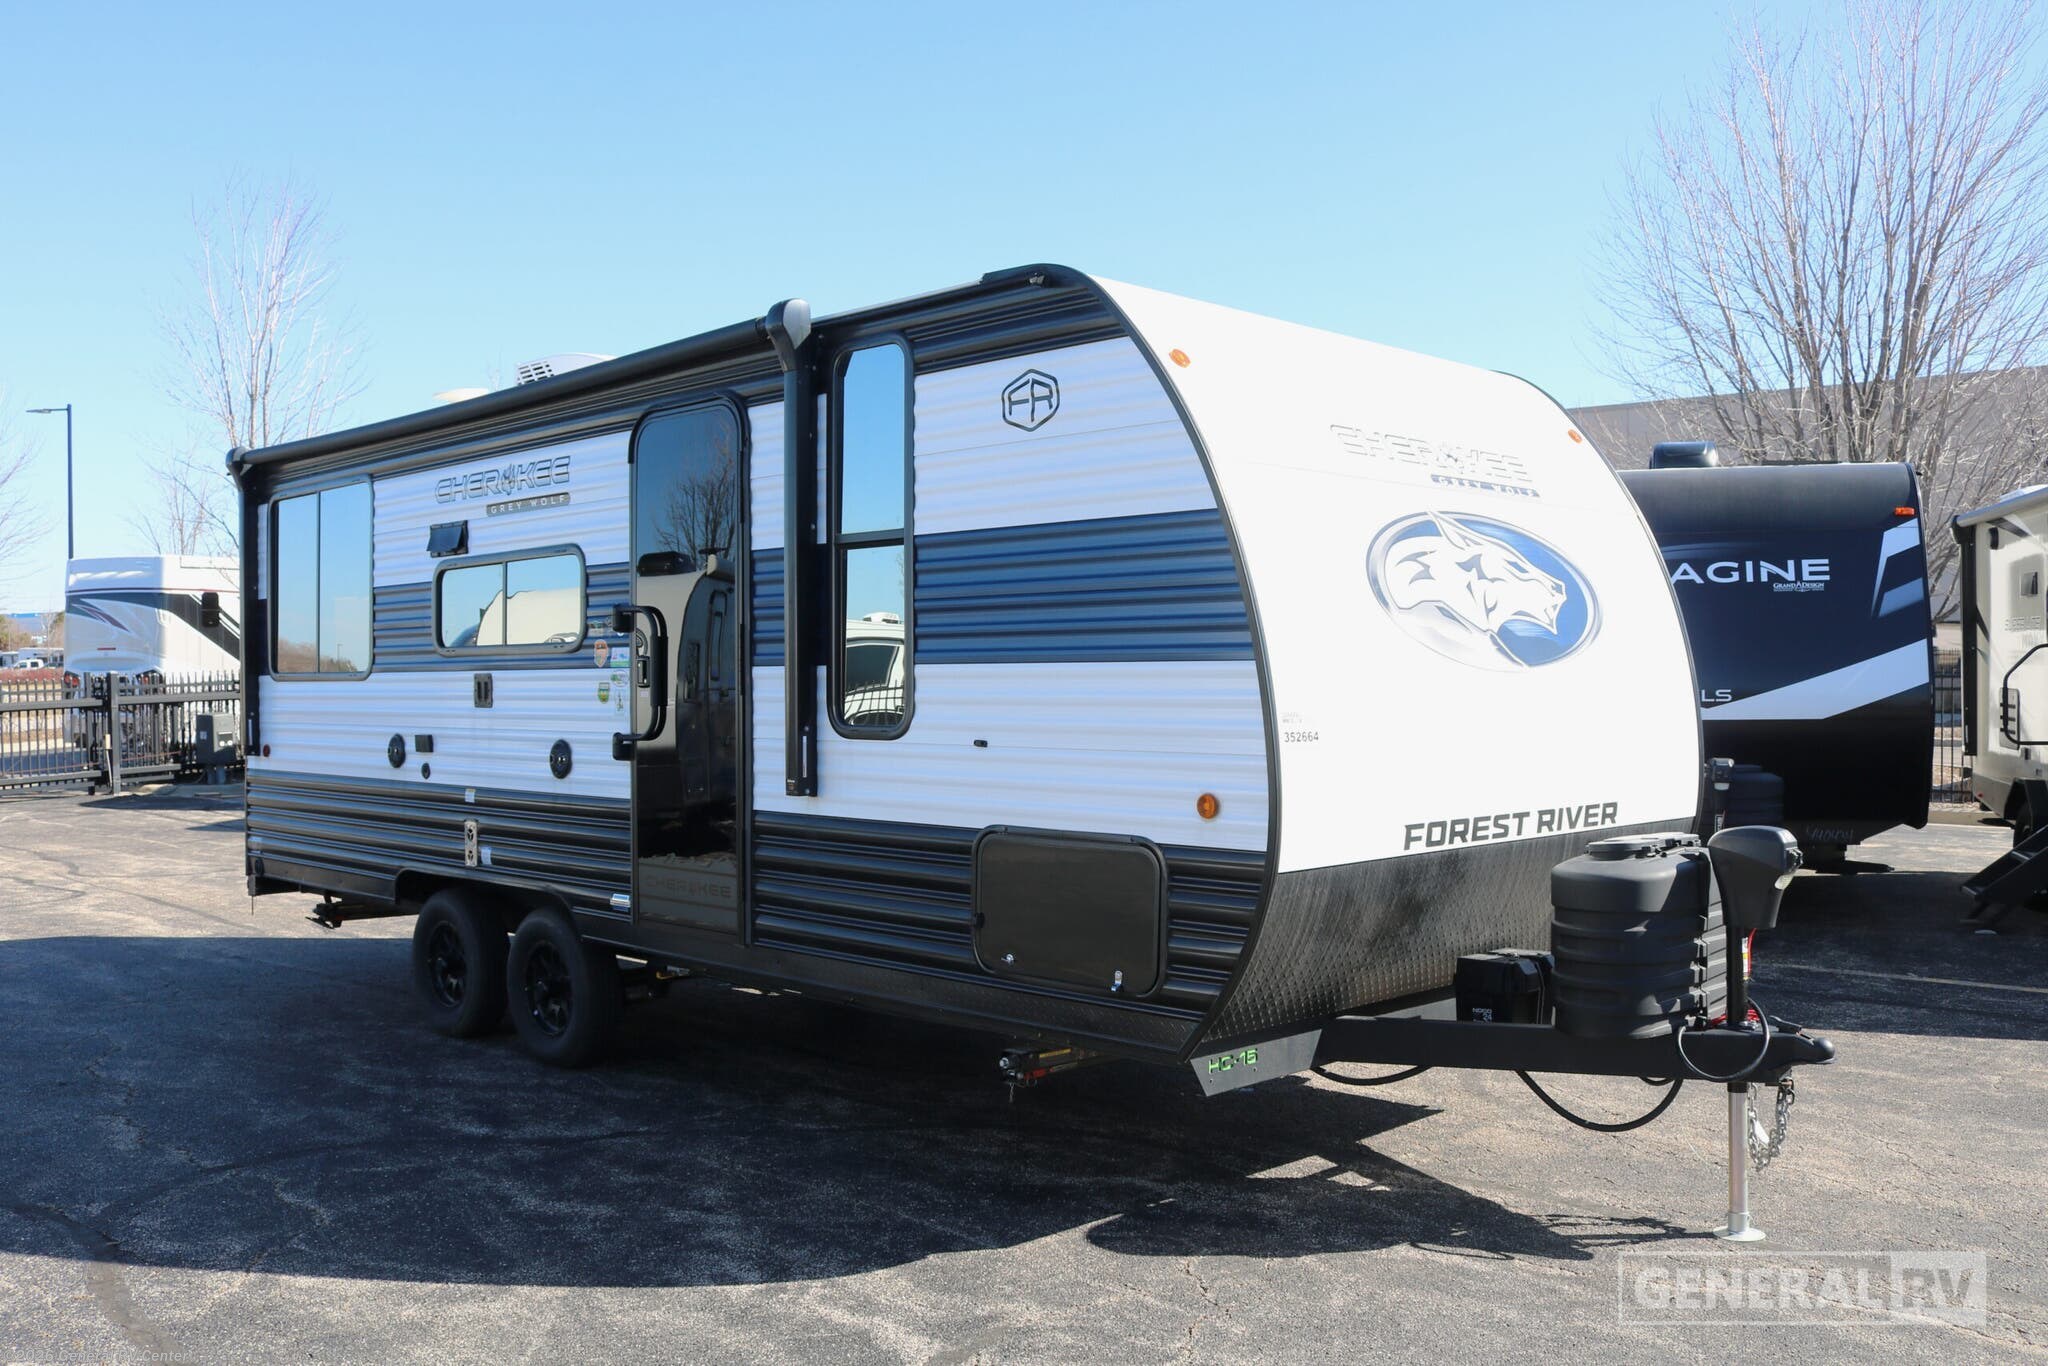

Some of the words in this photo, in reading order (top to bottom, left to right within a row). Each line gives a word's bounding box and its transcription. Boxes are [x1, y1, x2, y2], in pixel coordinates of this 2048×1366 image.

[434, 455, 571, 504] CHEROKEE
[490, 501, 523, 514] GREY
[531, 496, 567, 509] WOLF
[1671, 558, 1831, 585] AGINE
[1701, 689, 1733, 702] LS
[1283, 730, 1320, 743] 352664
[1404, 811, 1531, 851] FOREST
[1537, 801, 1619, 835] RIVER
[645, 875, 732, 898] CHEROKEE
